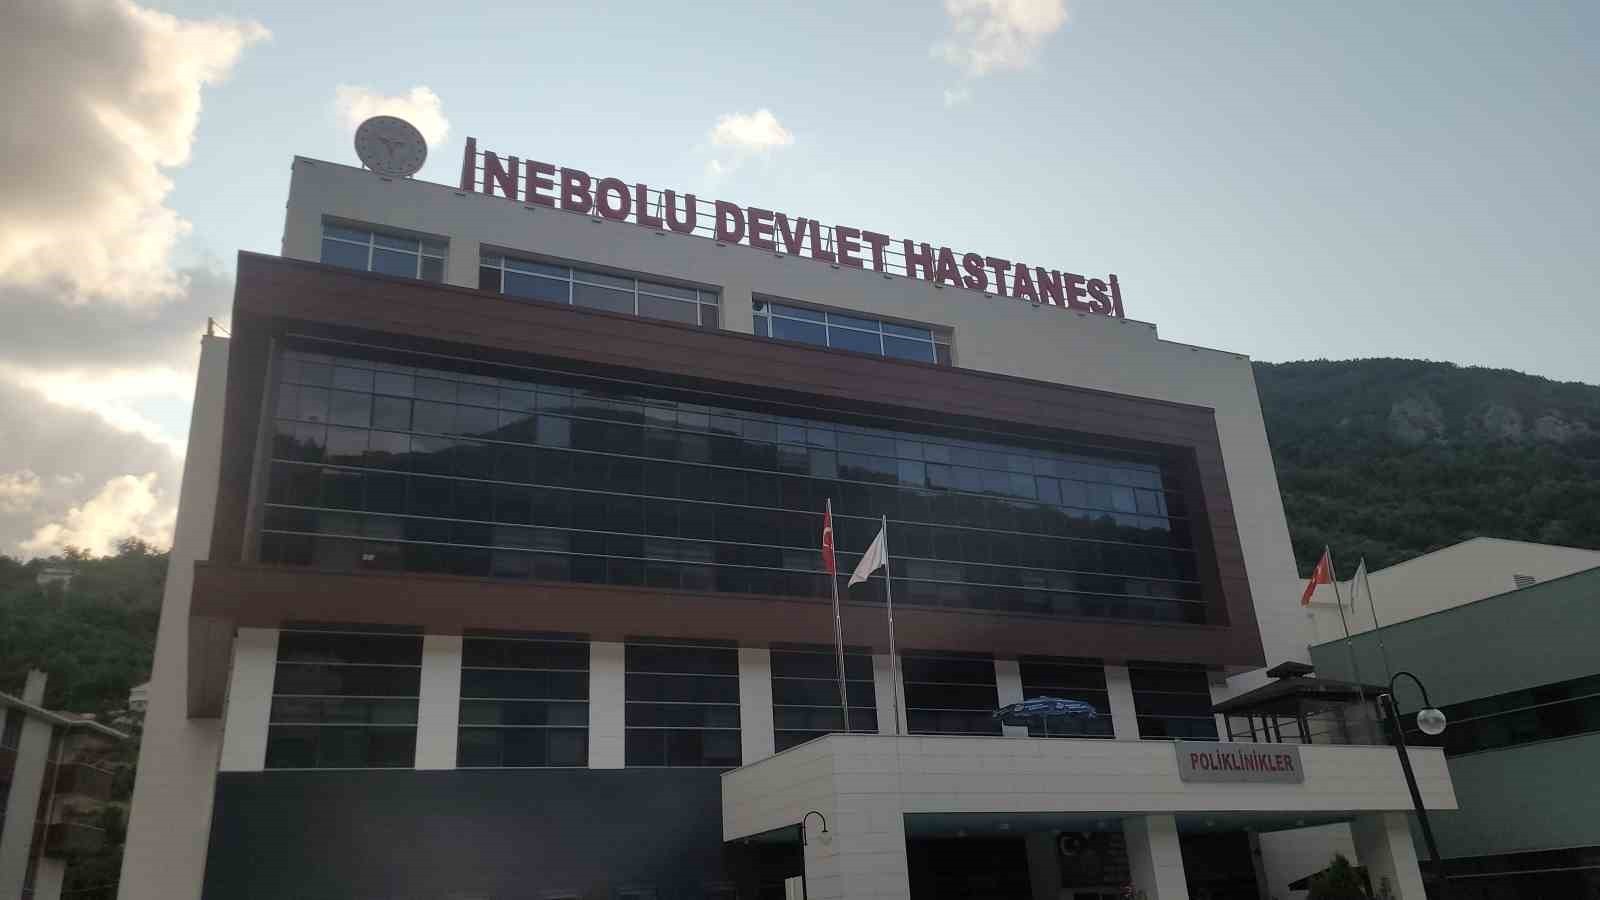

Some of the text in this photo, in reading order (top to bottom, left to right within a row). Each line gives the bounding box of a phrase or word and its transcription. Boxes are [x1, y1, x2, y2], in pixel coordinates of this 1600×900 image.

[463, 137, 1125, 318] İNEBOLU DEVLET HASTANESİ
[1190, 750, 1294, 772] POLİKLİNİKLER
